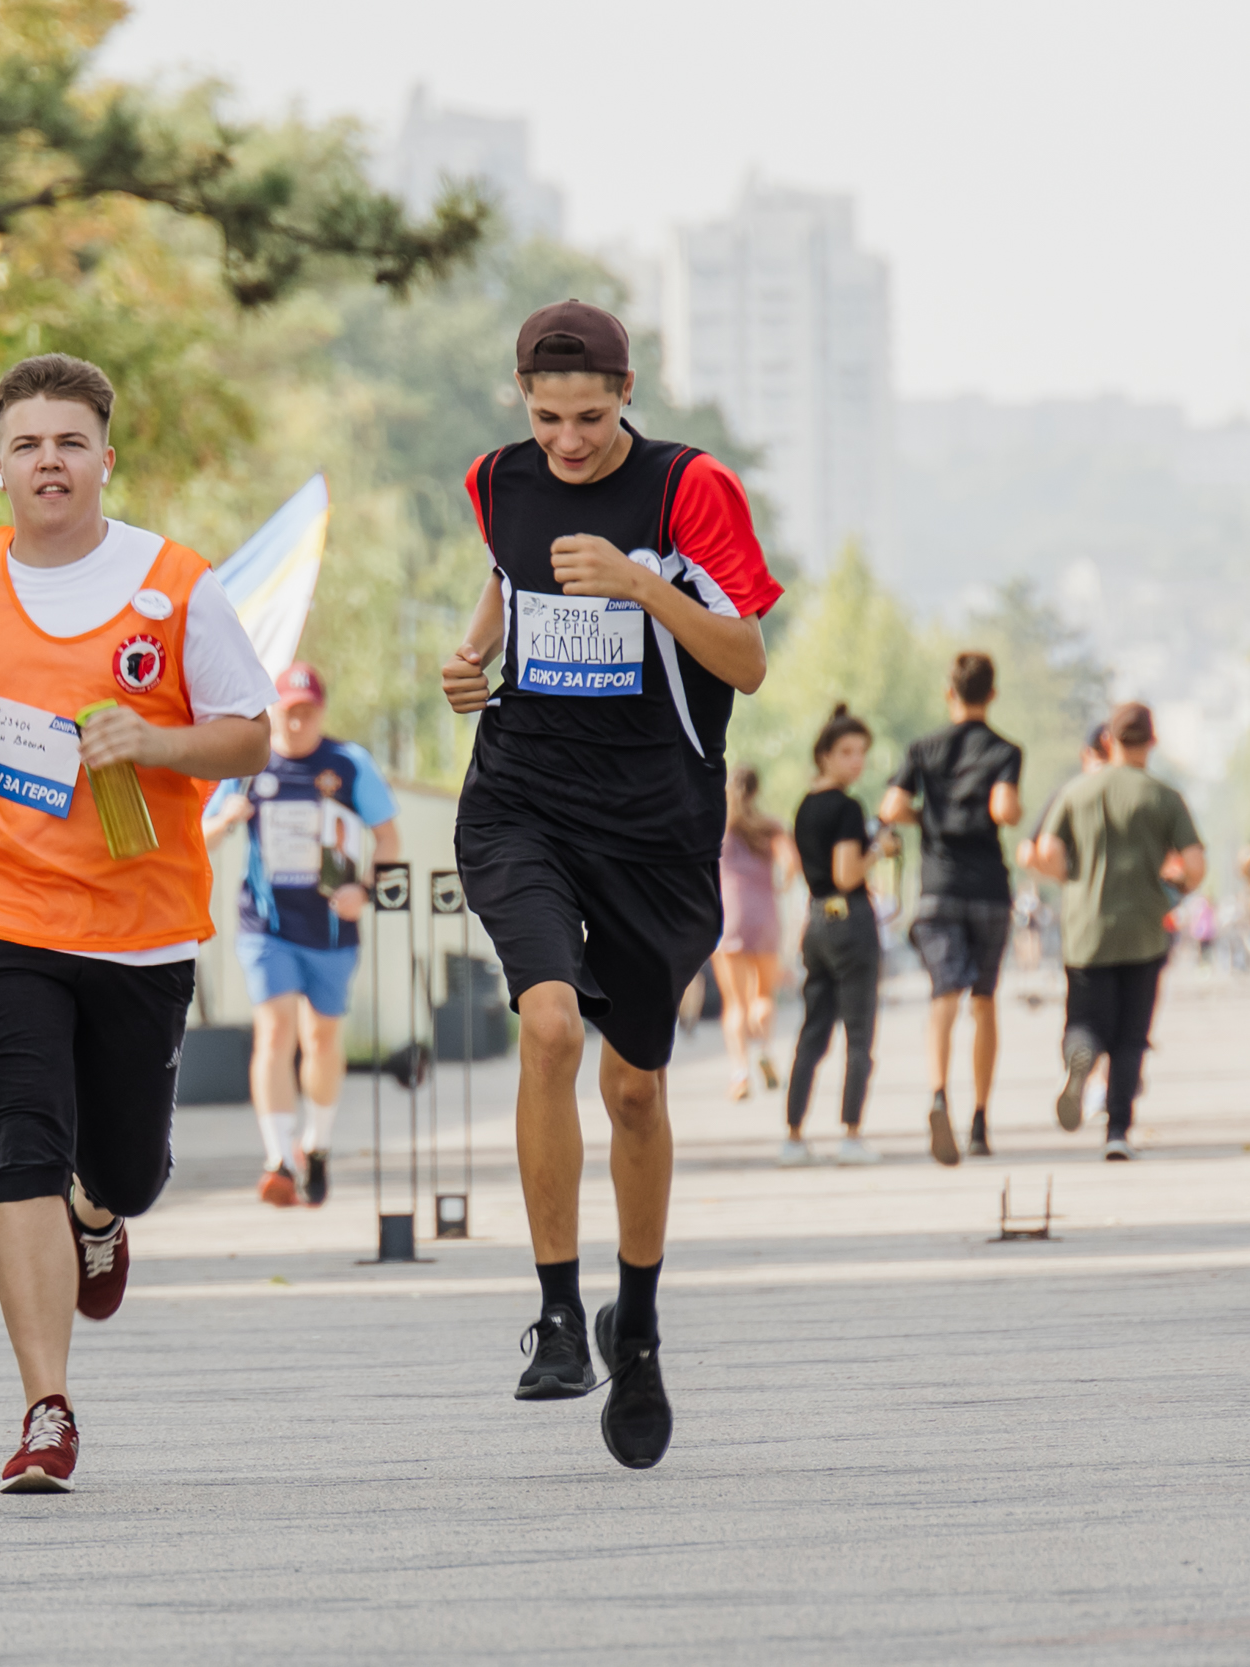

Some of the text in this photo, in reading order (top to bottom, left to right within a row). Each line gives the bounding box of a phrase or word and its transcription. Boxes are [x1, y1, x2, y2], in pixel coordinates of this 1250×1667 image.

[553, 608, 599, 623] 52916
[529, 667, 636, 689] БІЖУ ЗА ГЕРОЯ
[3, 775, 20, 794] ЗА
[21, 781, 68, 808] ГЕРОЯ
